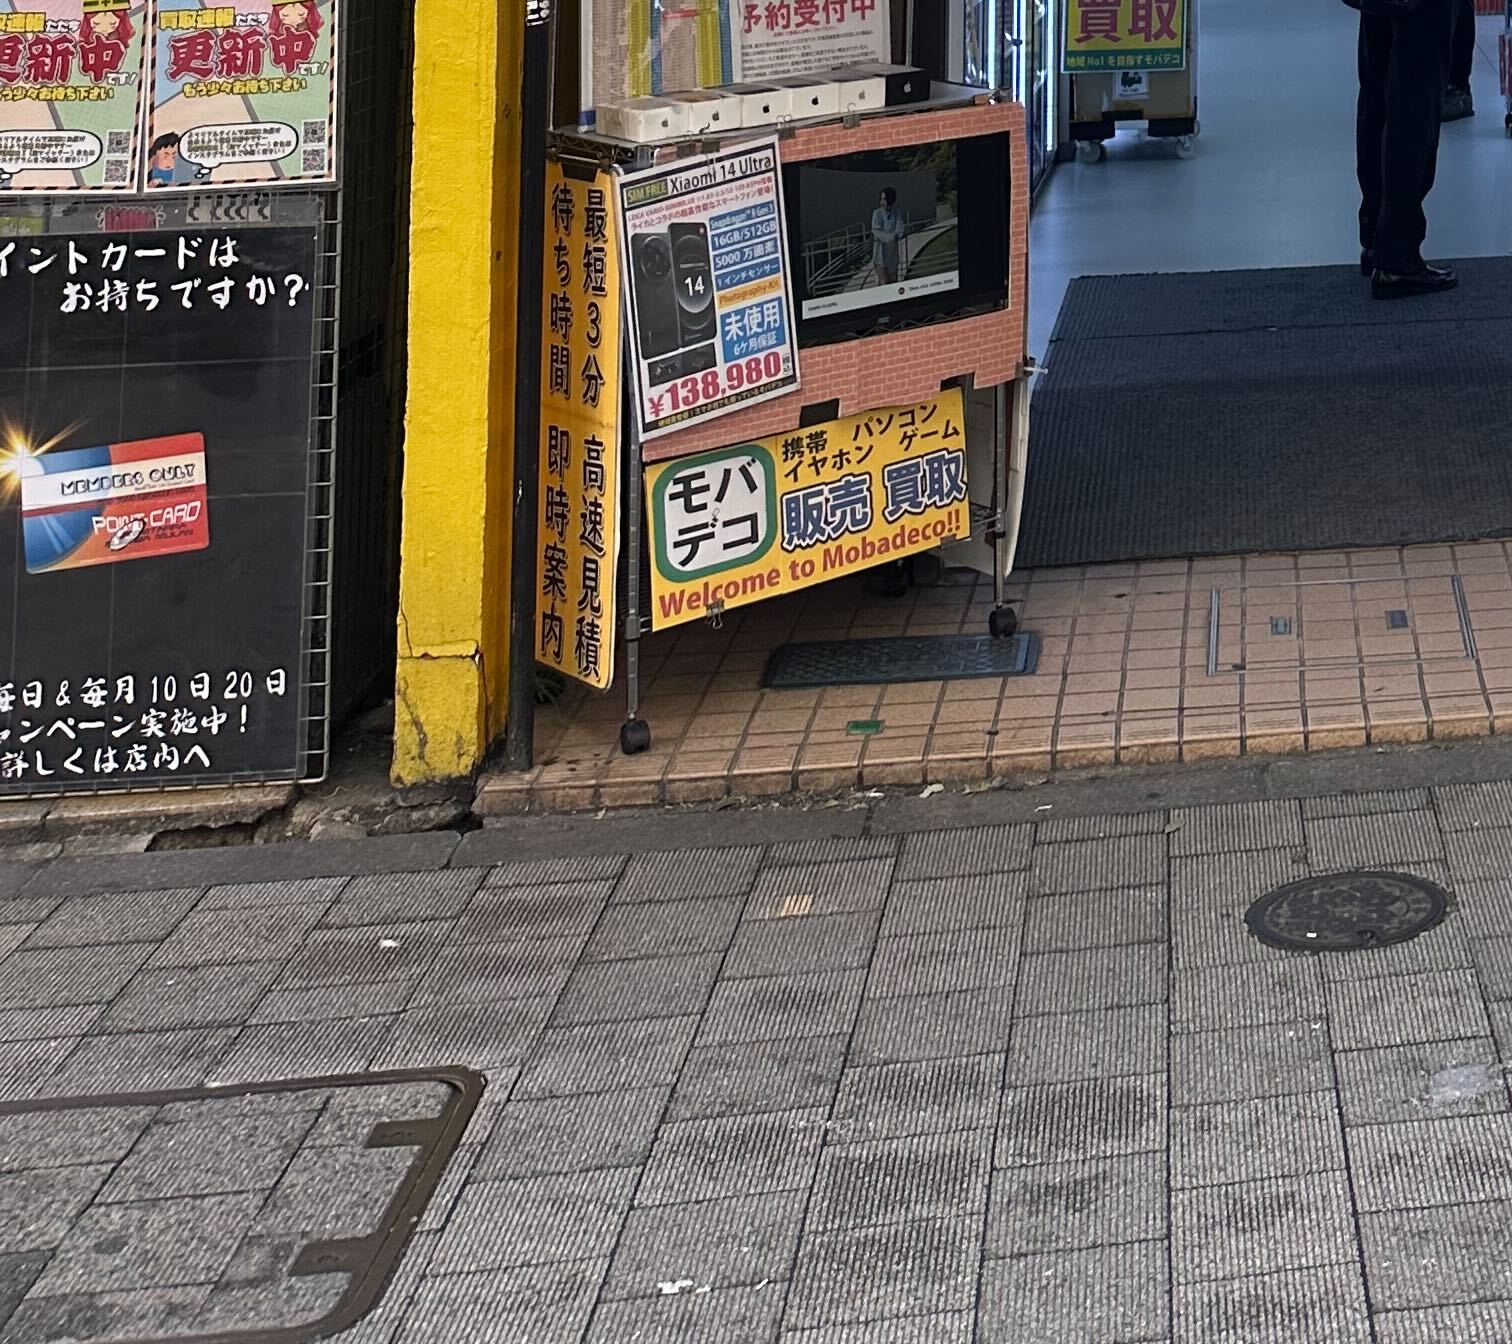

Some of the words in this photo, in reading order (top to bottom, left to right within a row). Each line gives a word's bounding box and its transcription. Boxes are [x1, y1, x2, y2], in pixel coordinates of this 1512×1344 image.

[165, 24, 317, 82] 更新中
[669, 166, 718, 195] Xiaomi
[719, 161, 737, 181] 14
[738, 154, 772, 176] Ultra
[547, 182, 576, 399] 待ち時間
[684, 274, 706, 298] 14
[724, 300, 781, 343] 未使用
[648, 351, 782, 419] ¥138,980
[781, 429, 829, 463] 携帯
[851, 403, 939, 443] パソコン
[783, 443, 875, 483] イヤホン
[898, 418, 961, 453] ゲーム
[668, 456, 759, 515] モバ
[780, 472, 873, 553] 販売
[881, 448, 969, 524] 買取
[540, 424, 572, 662] 即時案内
[574, 431, 607, 683] 高速見積
[657, 566, 782, 619] Welcome
[788, 558, 816, 582] to
[821, 508, 962, 573] Mobadeco!!
[672, 510, 760, 569] デコ
